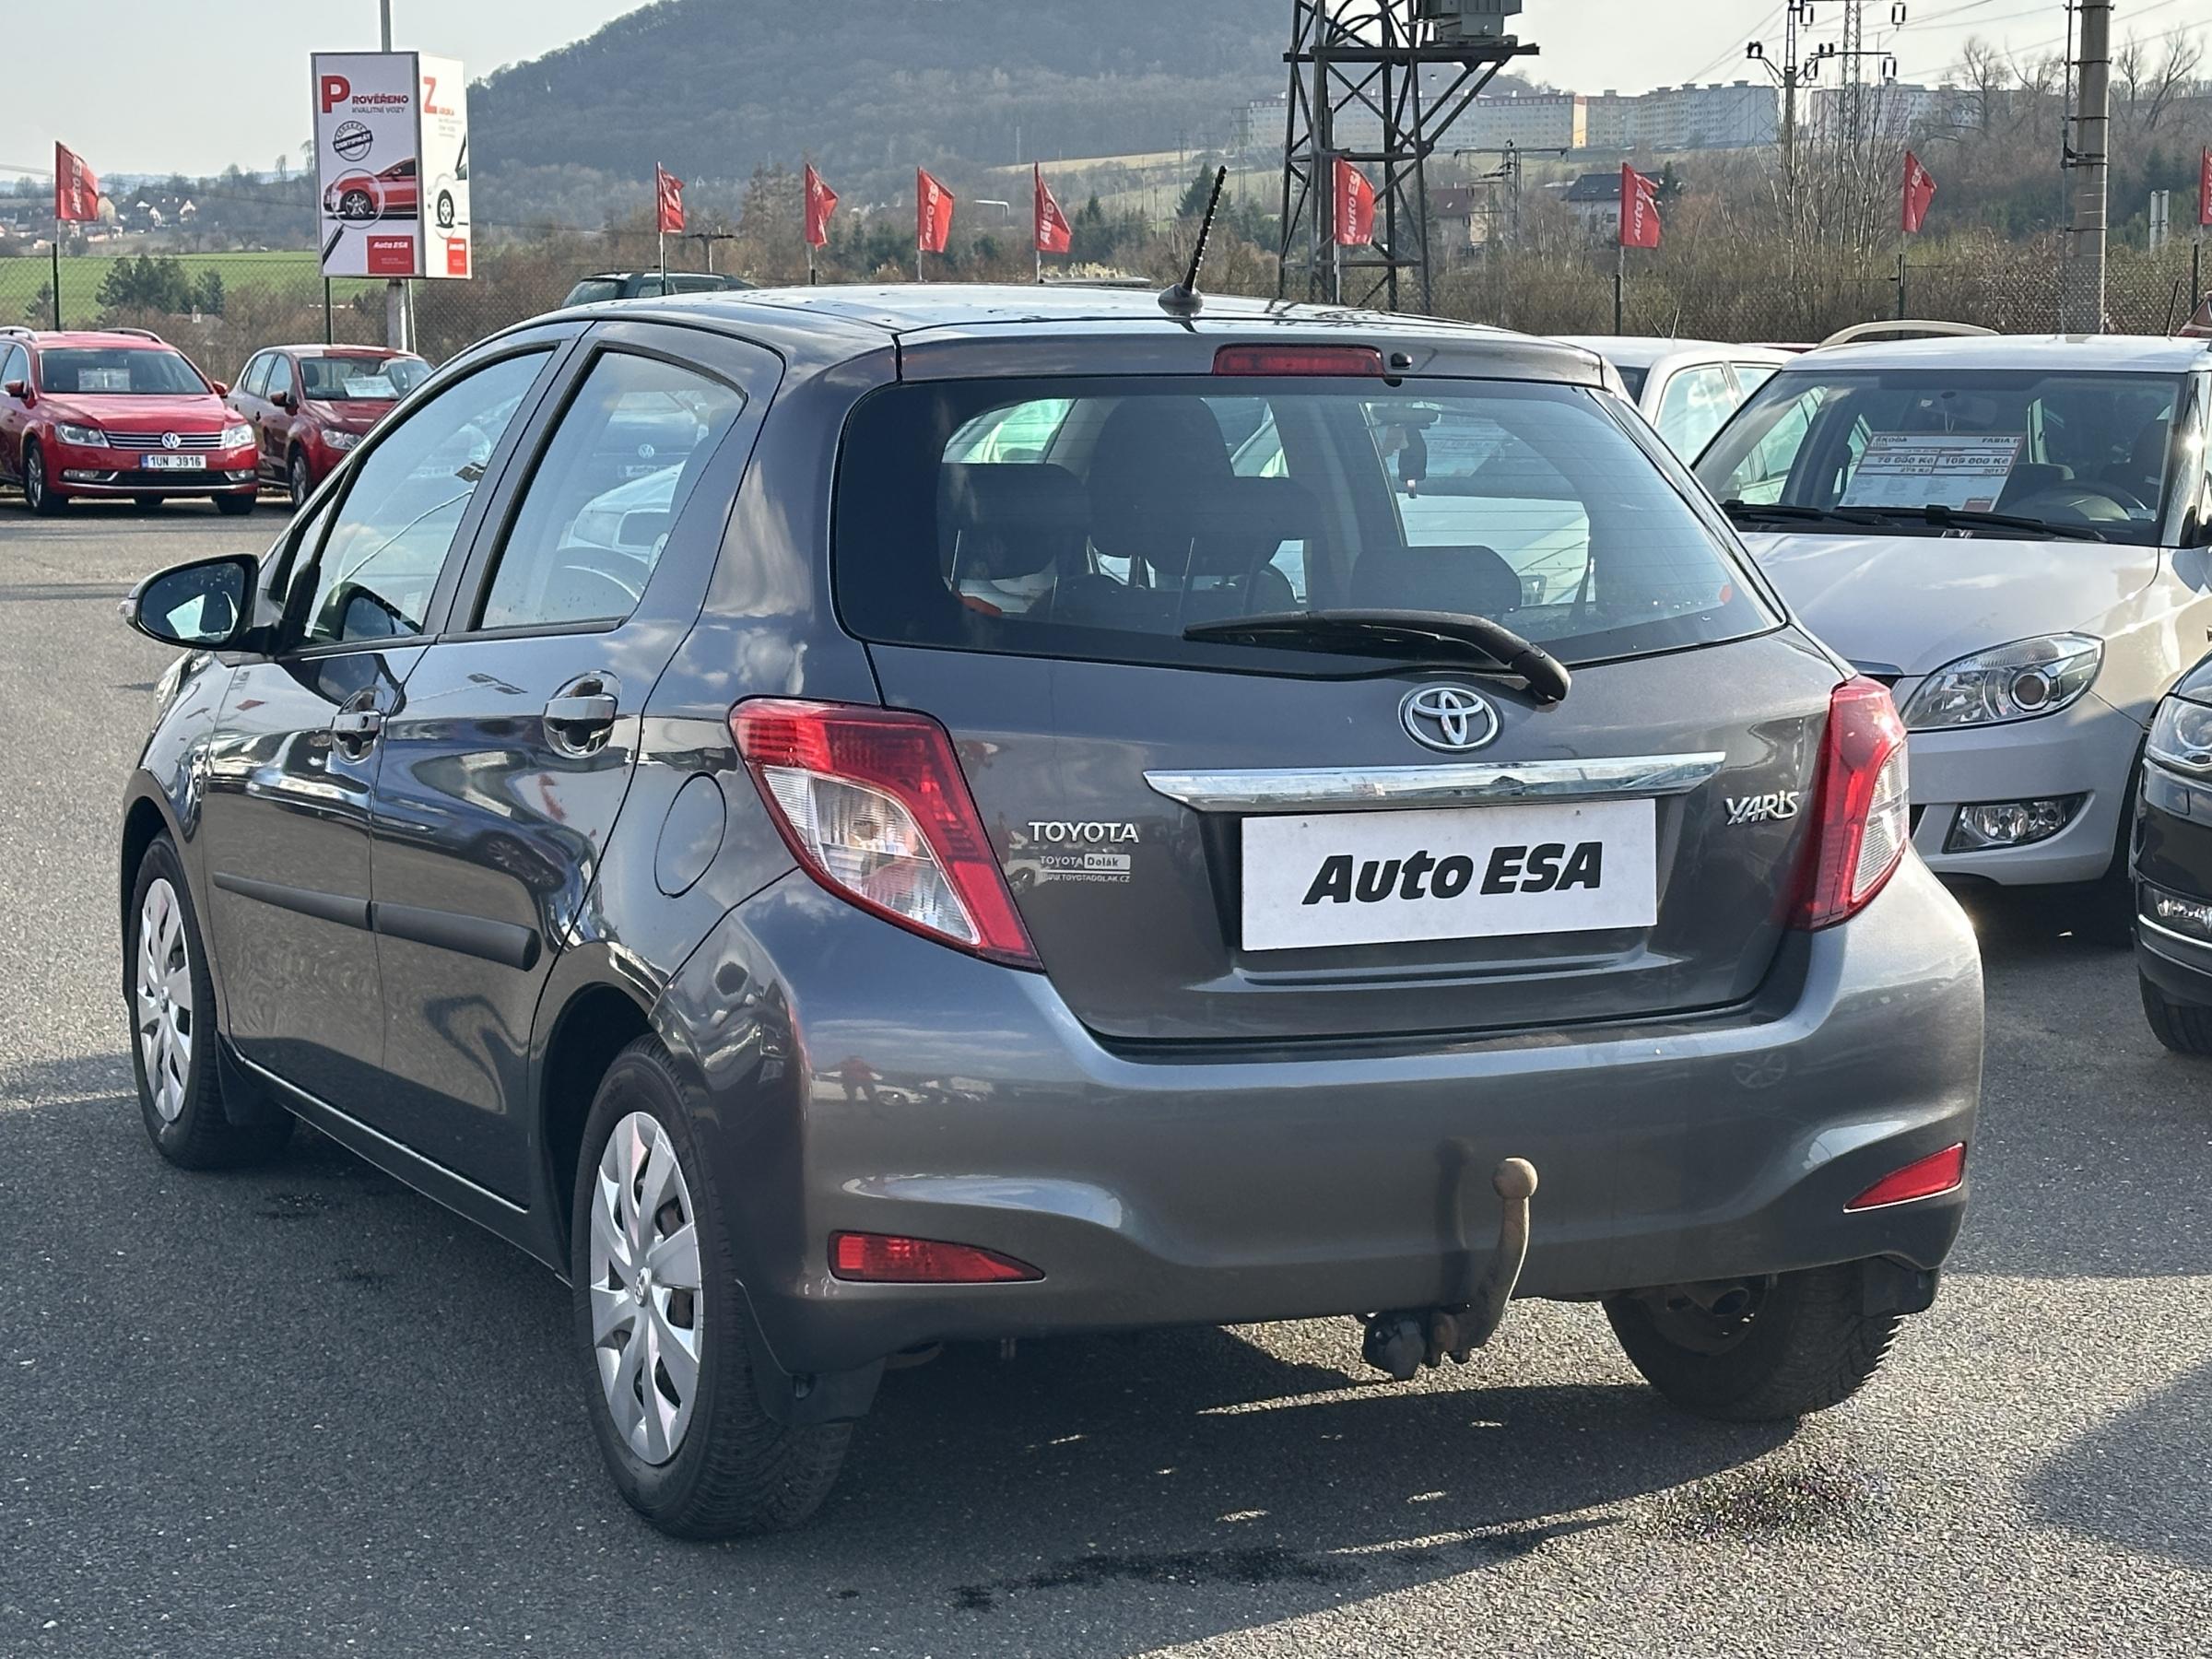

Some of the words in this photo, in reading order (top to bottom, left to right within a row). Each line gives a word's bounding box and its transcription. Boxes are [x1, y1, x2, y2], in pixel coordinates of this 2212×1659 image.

[150, 456, 170, 466] 1UN
[176, 456, 202, 466] 3916
[1028, 821, 1139, 843] TOYOTA
[1040, 855, 1083, 867] TOYOTA
[1301, 850, 1475, 905] Auto
[1479, 841, 1603, 896] ESA
